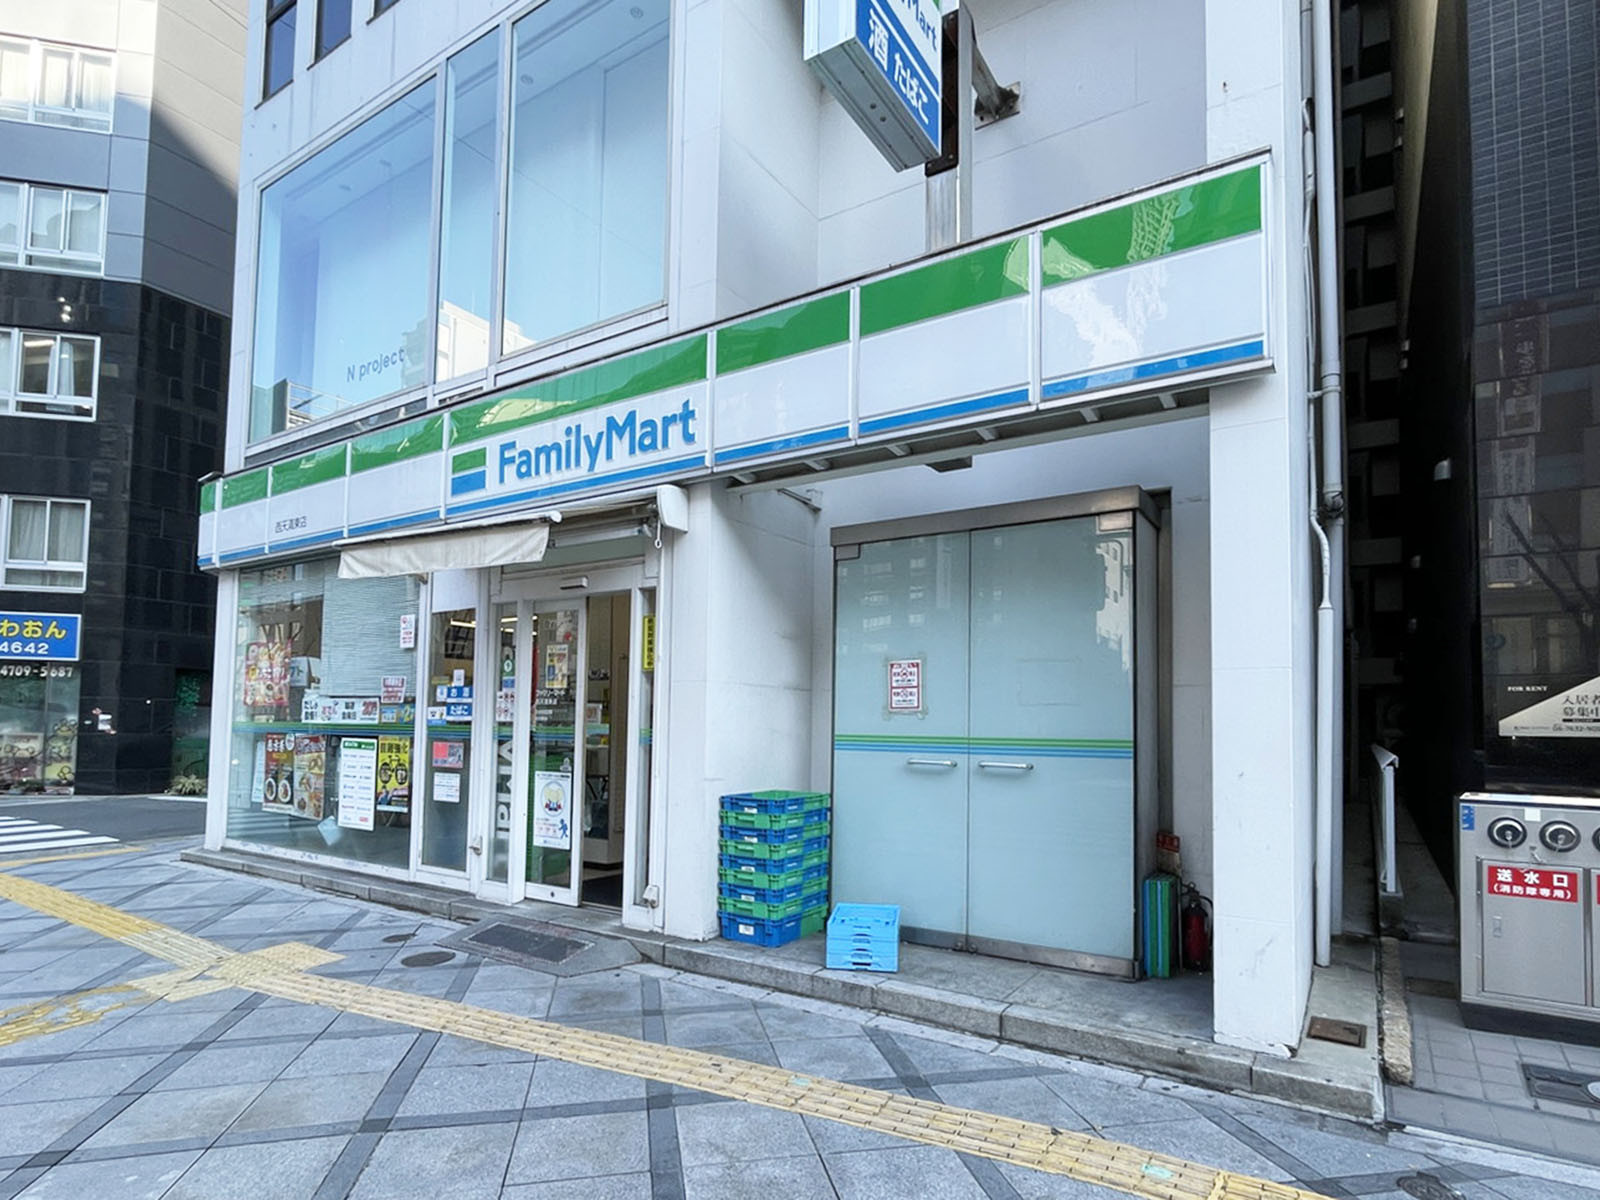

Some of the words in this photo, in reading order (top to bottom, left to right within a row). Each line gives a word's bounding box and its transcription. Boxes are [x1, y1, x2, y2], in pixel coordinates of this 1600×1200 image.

[869, 8, 889, 72] 酒
[895, 53, 928, 125] たばこ
[347, 364, 355, 382] N
[359, 348, 405, 381] project
[499, 399, 697, 485] FamilyMart
[0, 619, 67, 638] わおん
[0, 641, 49, 654] 4642
[0, 665, 73, 678] 4709-5687
[1496, 868, 1568, 887] 送水口
[1493, 883, 1572, 899] (消防隊専用)
